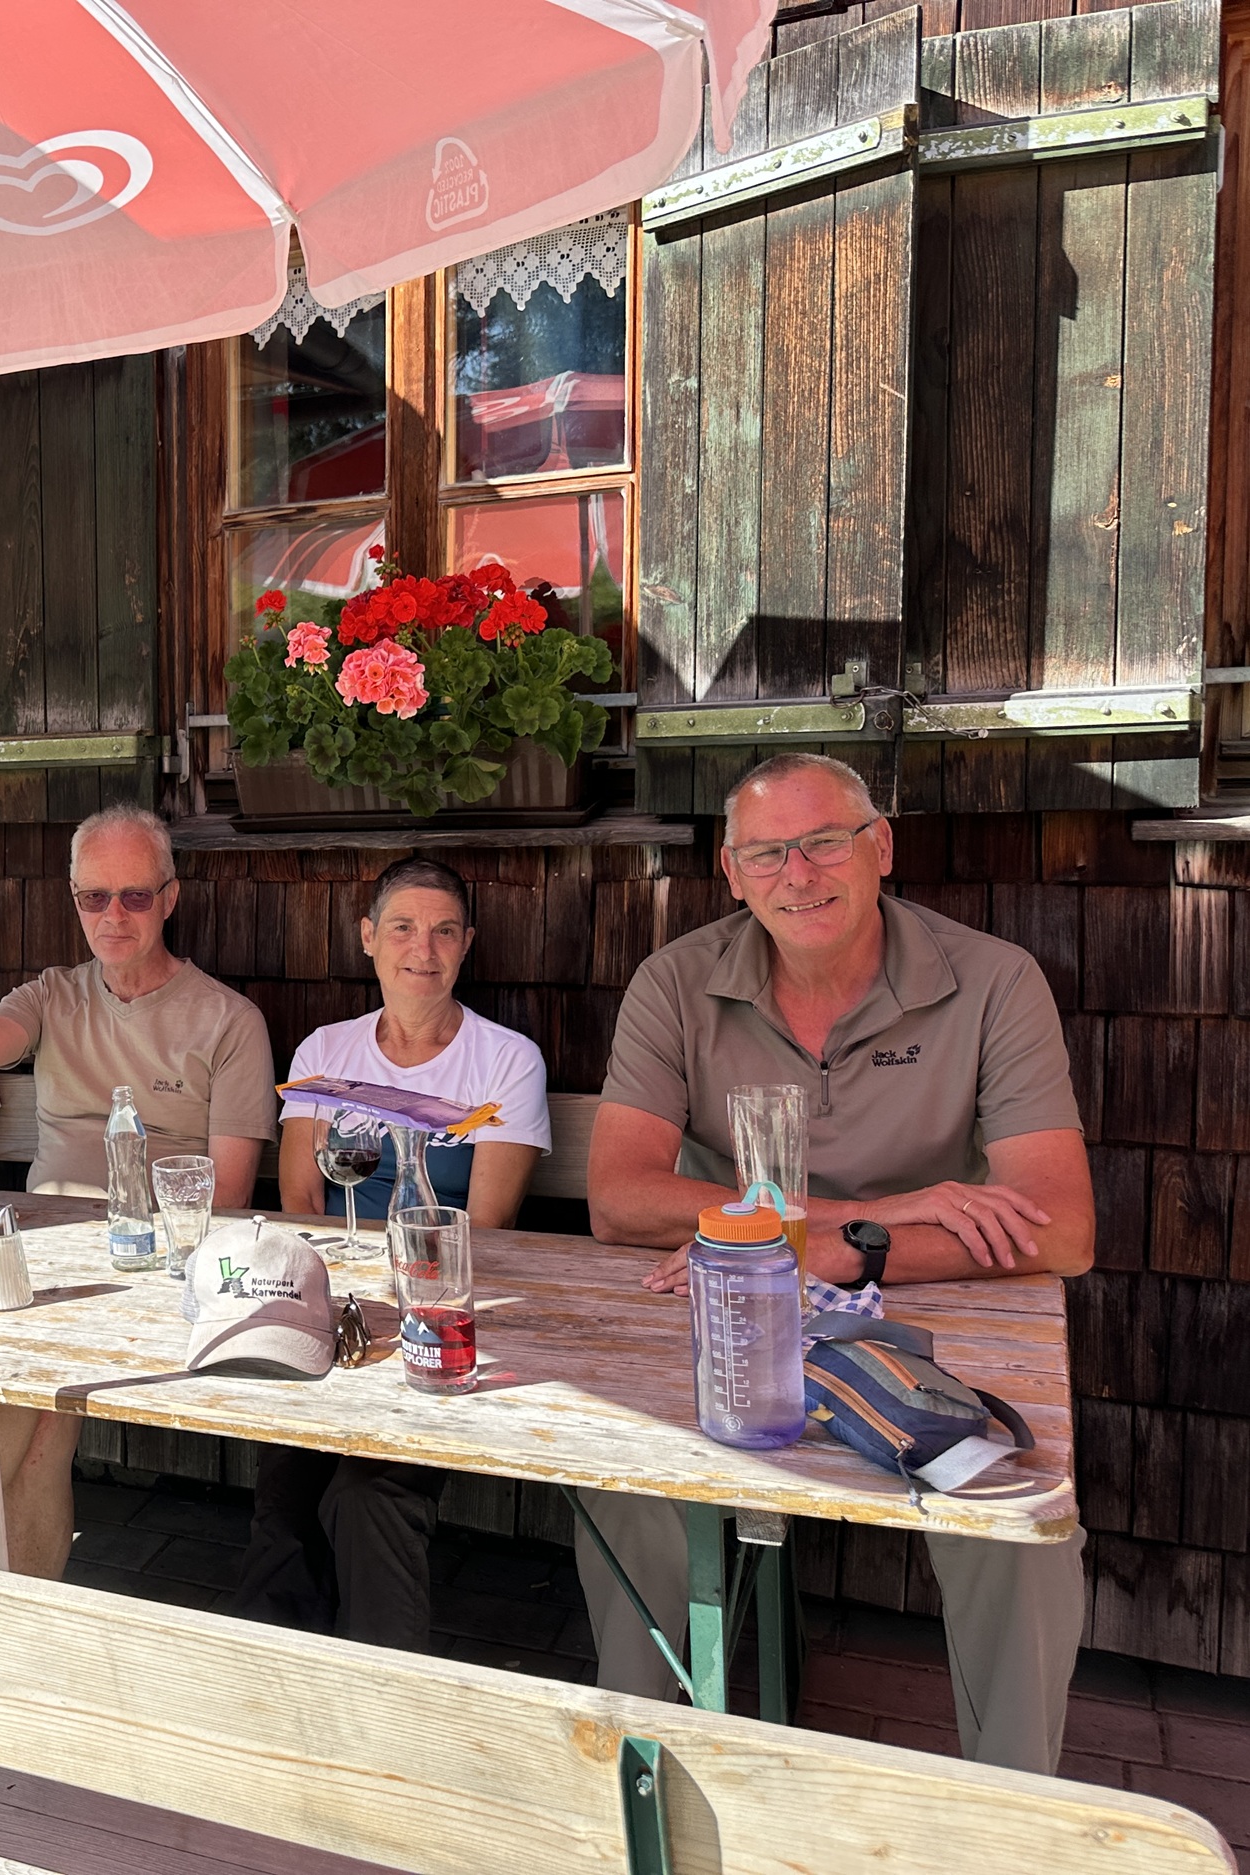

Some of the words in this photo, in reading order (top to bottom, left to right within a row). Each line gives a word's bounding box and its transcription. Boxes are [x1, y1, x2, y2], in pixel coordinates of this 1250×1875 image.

[871, 1050, 897, 1059] Jack
[871, 1056, 918, 1067] Wolfskin
[154, 1078, 169, 1087] Jack
[152, 1085, 182, 1094] Wolfskin
[251, 1277, 295, 1288] Naturpark
[251, 1288, 302, 1301] Karwendel
